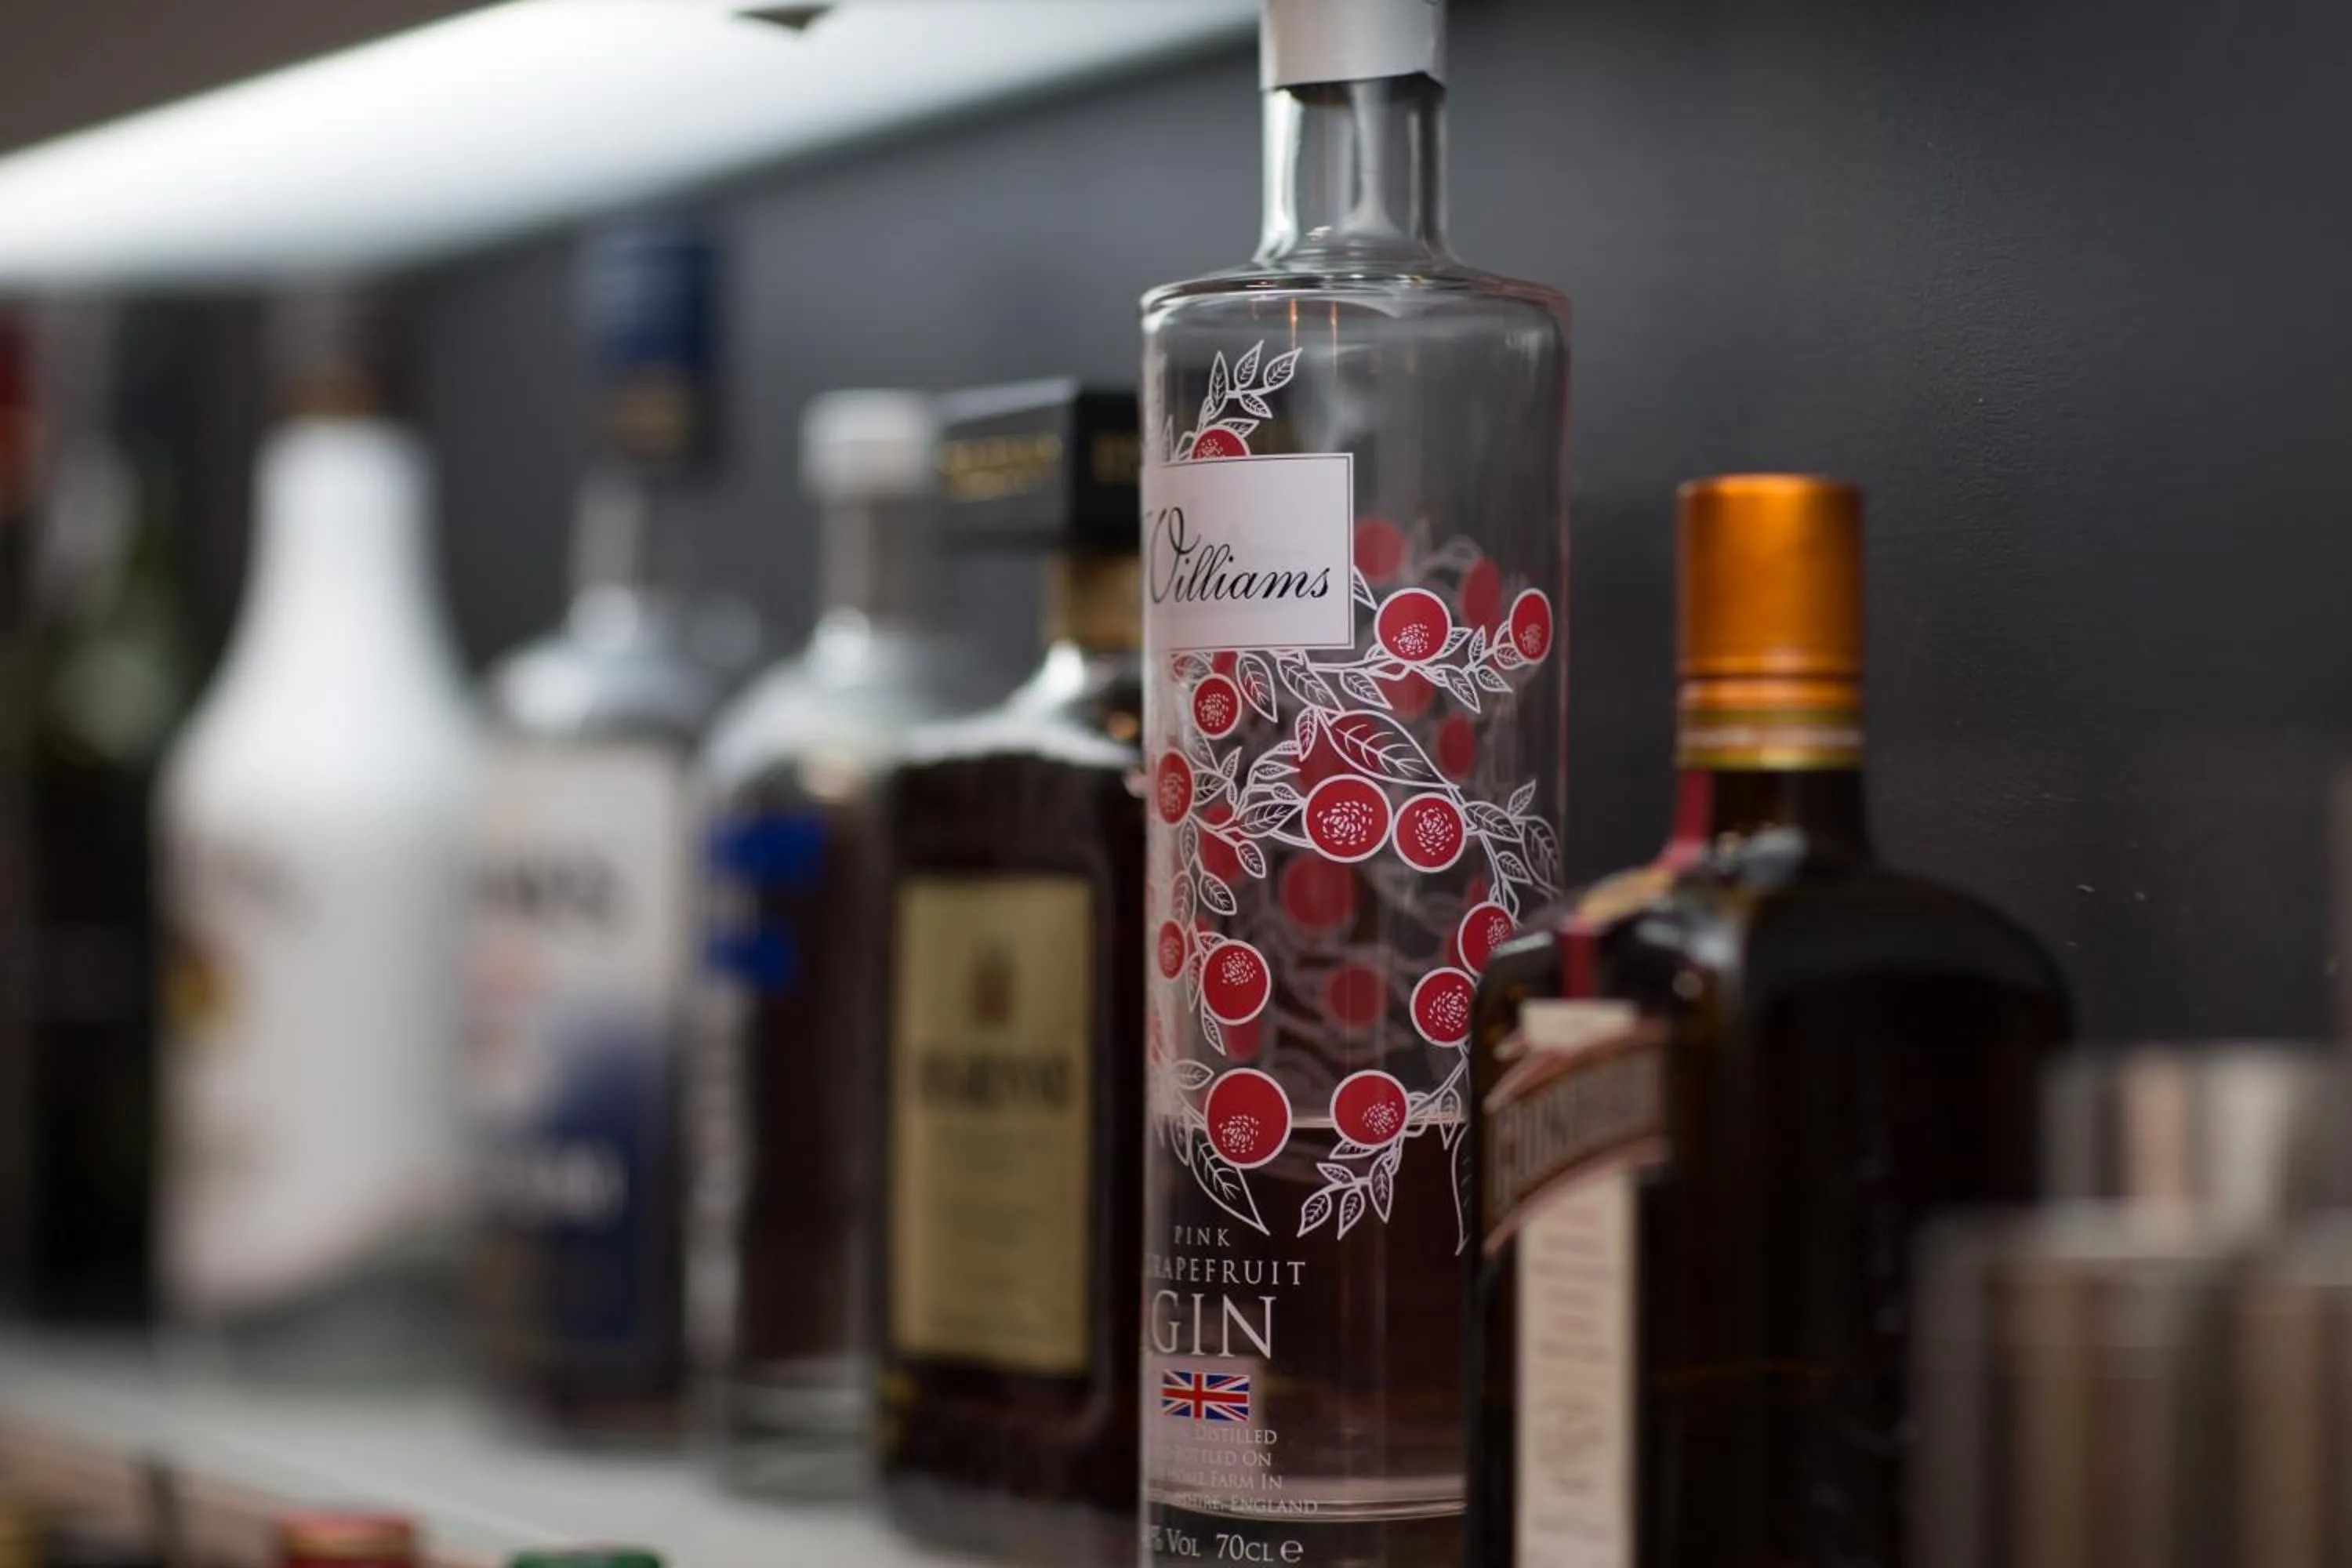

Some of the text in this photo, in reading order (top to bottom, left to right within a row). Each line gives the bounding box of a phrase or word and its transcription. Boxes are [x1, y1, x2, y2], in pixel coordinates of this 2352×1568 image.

[1150, 506, 1330, 604] Williams
[1174, 1225, 1230, 1247] PINK
[1151, 1290, 1277, 1359] GIN
[1194, 1424, 1277, 1445] DISTILLED
[1242, 1449, 1272, 1467] ON
[1210, 1470, 1254, 1490] FARM
[1260, 1473, 1283, 1491] IN
[1230, 1494, 1318, 1515] ENGLAND
